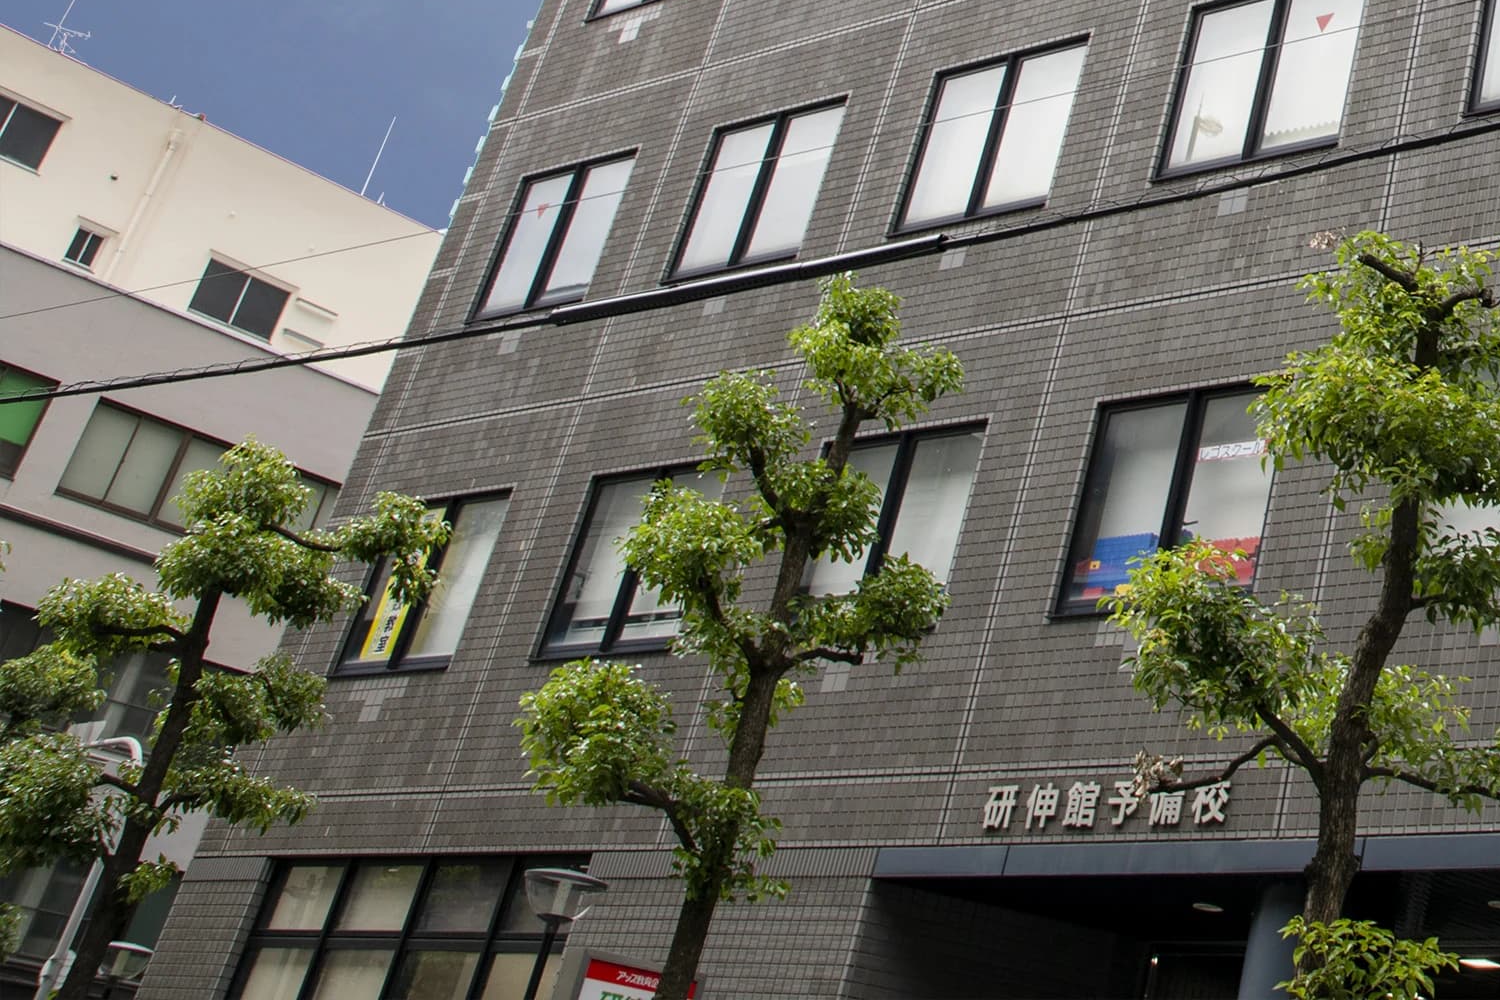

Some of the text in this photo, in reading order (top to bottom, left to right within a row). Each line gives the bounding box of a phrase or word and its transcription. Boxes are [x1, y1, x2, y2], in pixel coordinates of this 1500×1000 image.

[1200, 440, 1261, 458] レゴスクール
[982, 780, 1232, 830] 研伸館予備校
